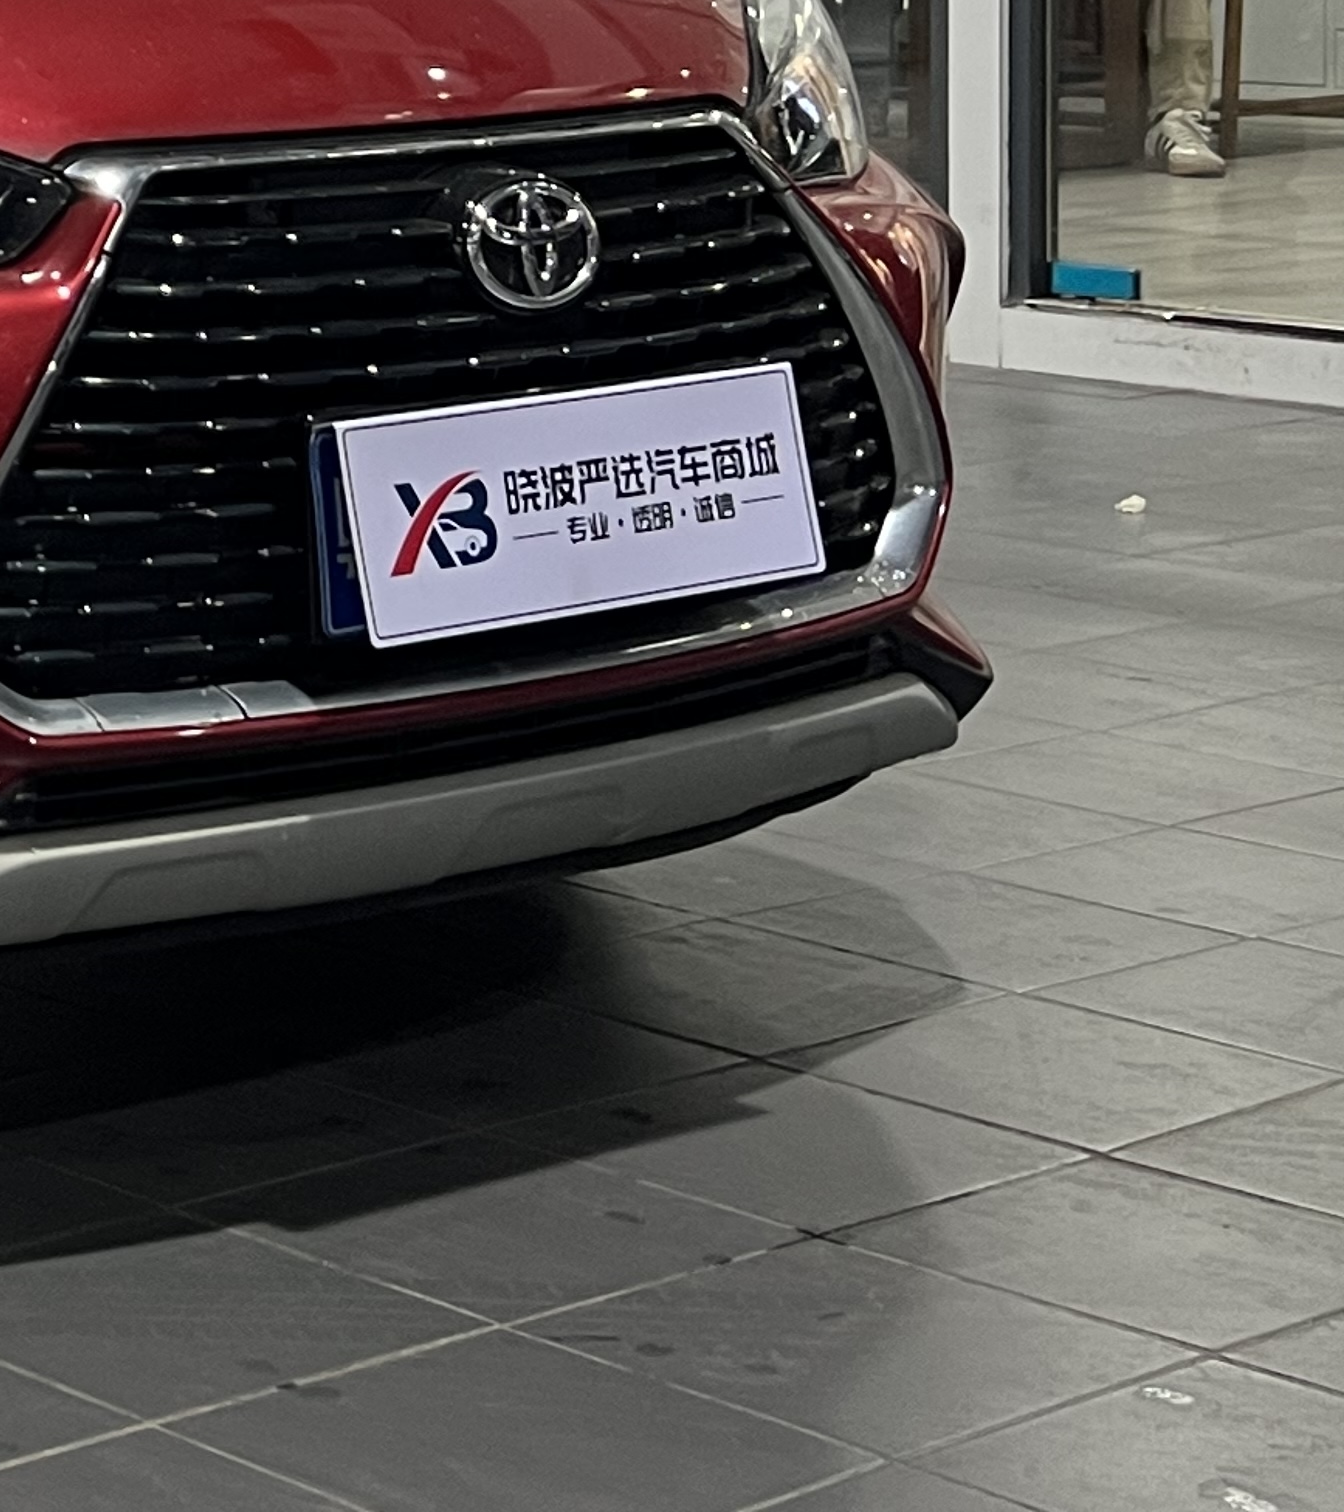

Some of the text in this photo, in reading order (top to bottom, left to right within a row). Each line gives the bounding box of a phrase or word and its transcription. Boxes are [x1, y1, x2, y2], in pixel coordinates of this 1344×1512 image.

[503, 432, 780, 515] 晓波严选汽车商城
